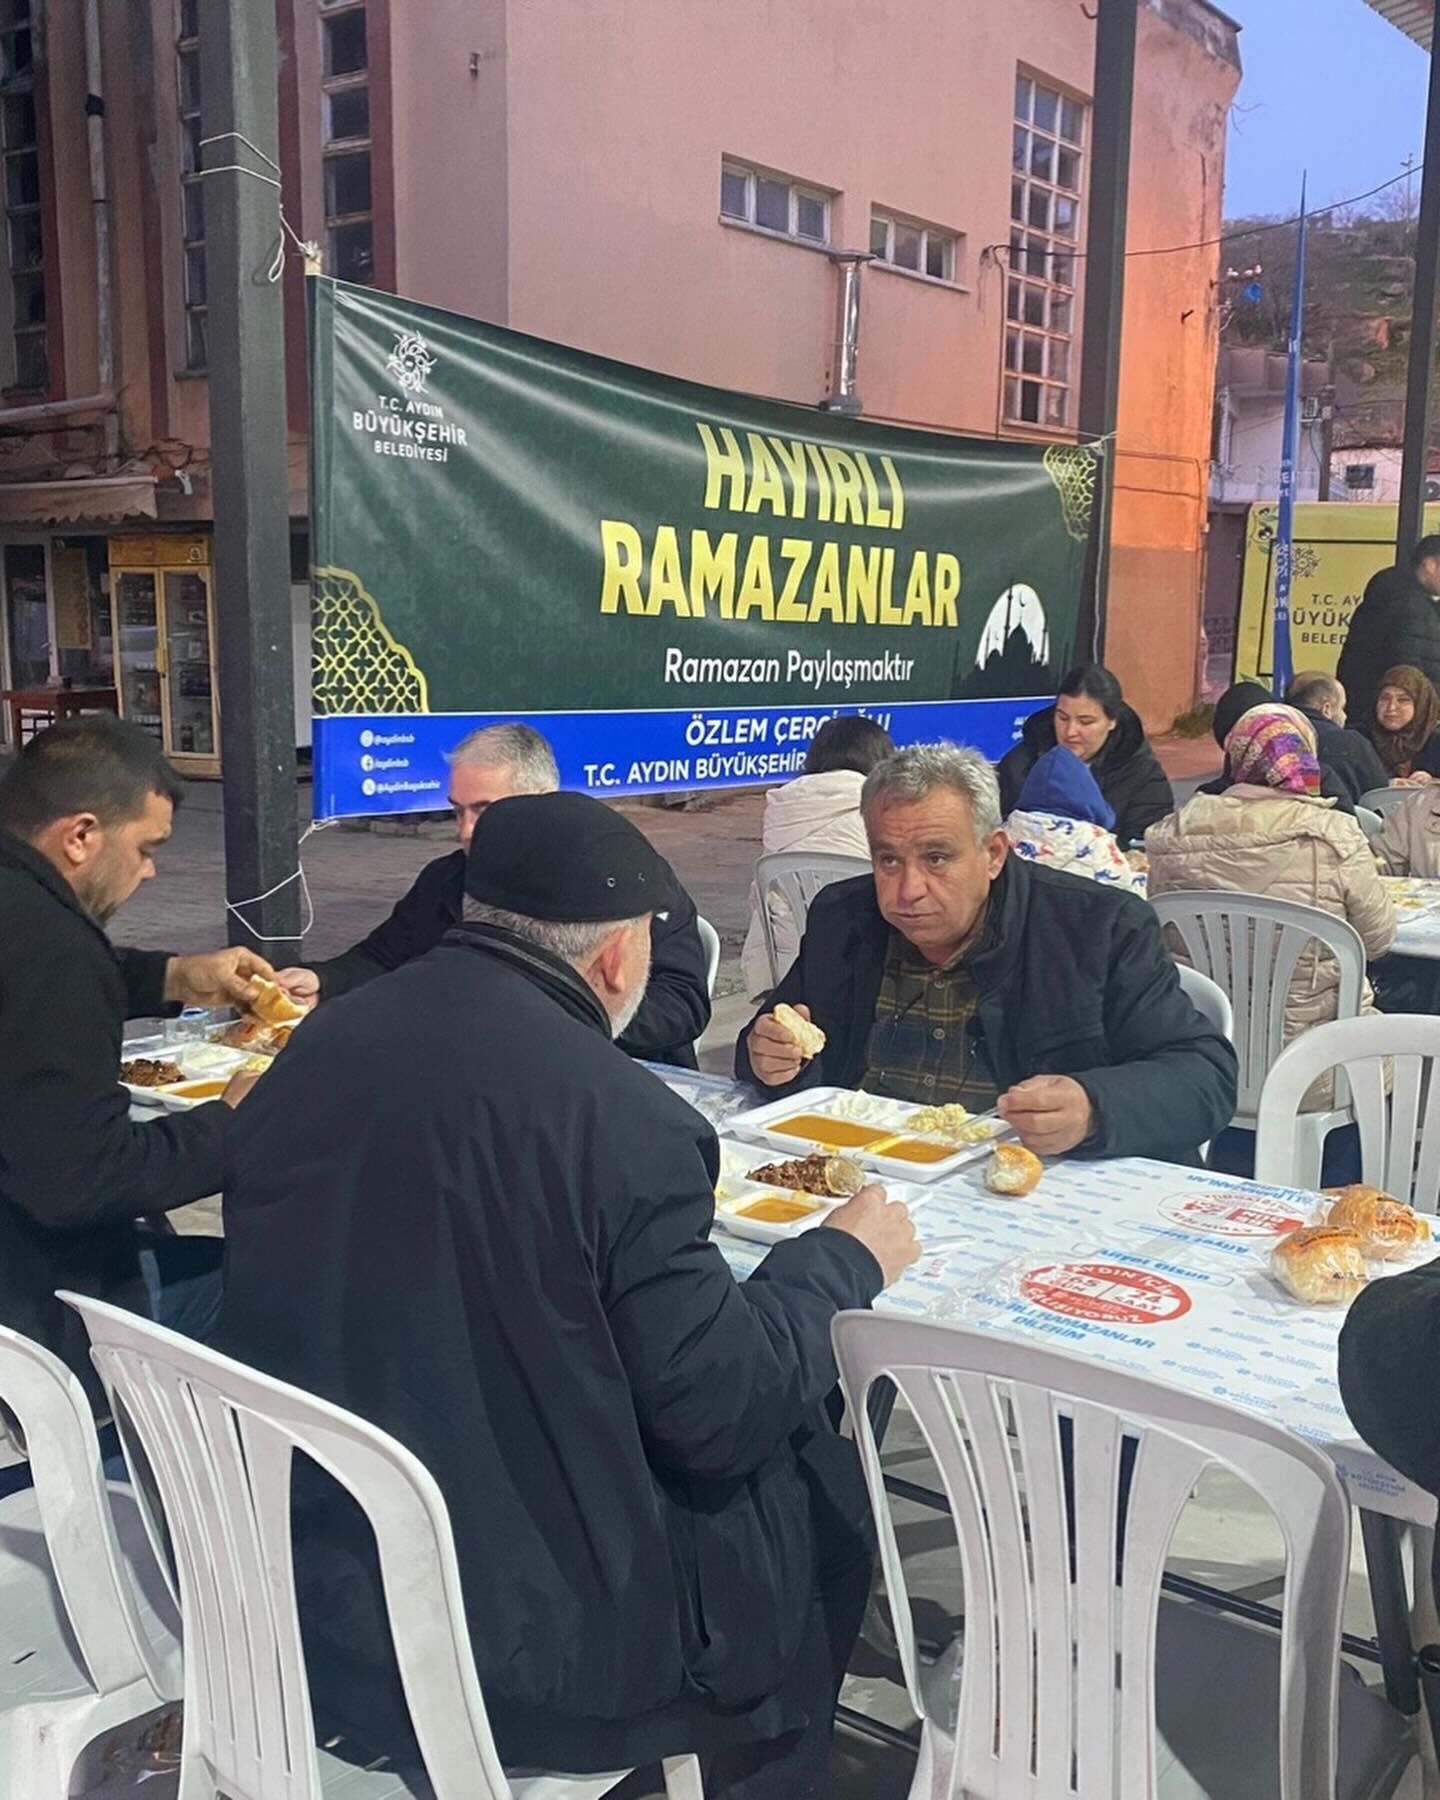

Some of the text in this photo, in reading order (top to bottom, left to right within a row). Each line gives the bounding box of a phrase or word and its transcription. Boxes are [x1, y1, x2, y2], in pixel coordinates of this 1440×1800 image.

[379, 395, 443, 418] T.C. AYDIN
[353, 410, 467, 446] BÜYÜKŞEHİR
[374, 440, 448, 462] BELEDİYESİ
[697, 423, 904, 529] HAYIRLI
[600, 519, 961, 627] RAMAZANLAR
[1293, 607, 1350, 627] ÜYÜK
[1312, 593, 1361, 605] T.C. AY
[664, 648, 914, 690] Ramazan Paylaşmaktır
[685, 714, 768, 745] ÖZLEM
[584, 748, 807, 787] T.C. AYDIN BÜYÜKŞEHİR
[1038, 1311, 1157, 1348] RAMAZANLAR
